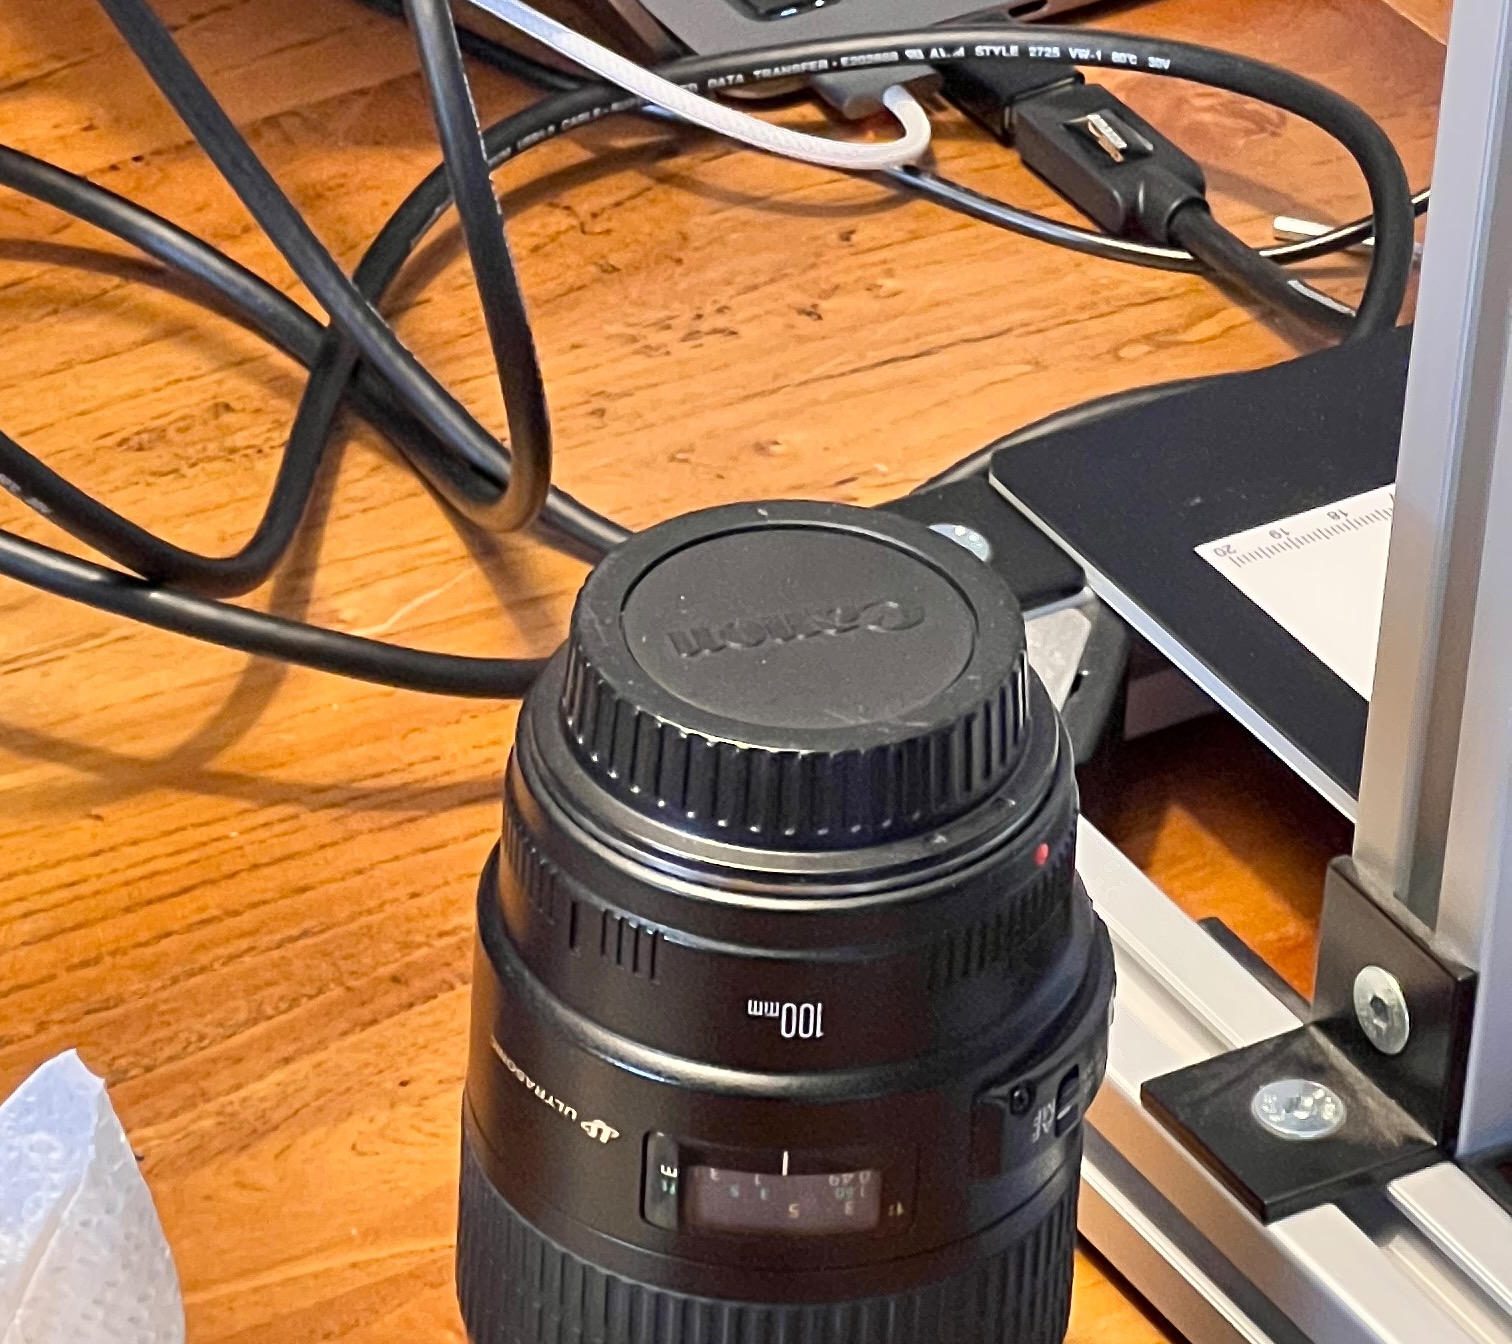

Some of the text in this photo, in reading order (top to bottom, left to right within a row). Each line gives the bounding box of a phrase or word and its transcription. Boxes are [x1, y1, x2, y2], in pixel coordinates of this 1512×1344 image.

[975, 45, 1019, 58] STYLE
[1213, 544, 1237, 558] 20
[748, 999, 825, 1039] 100mm
